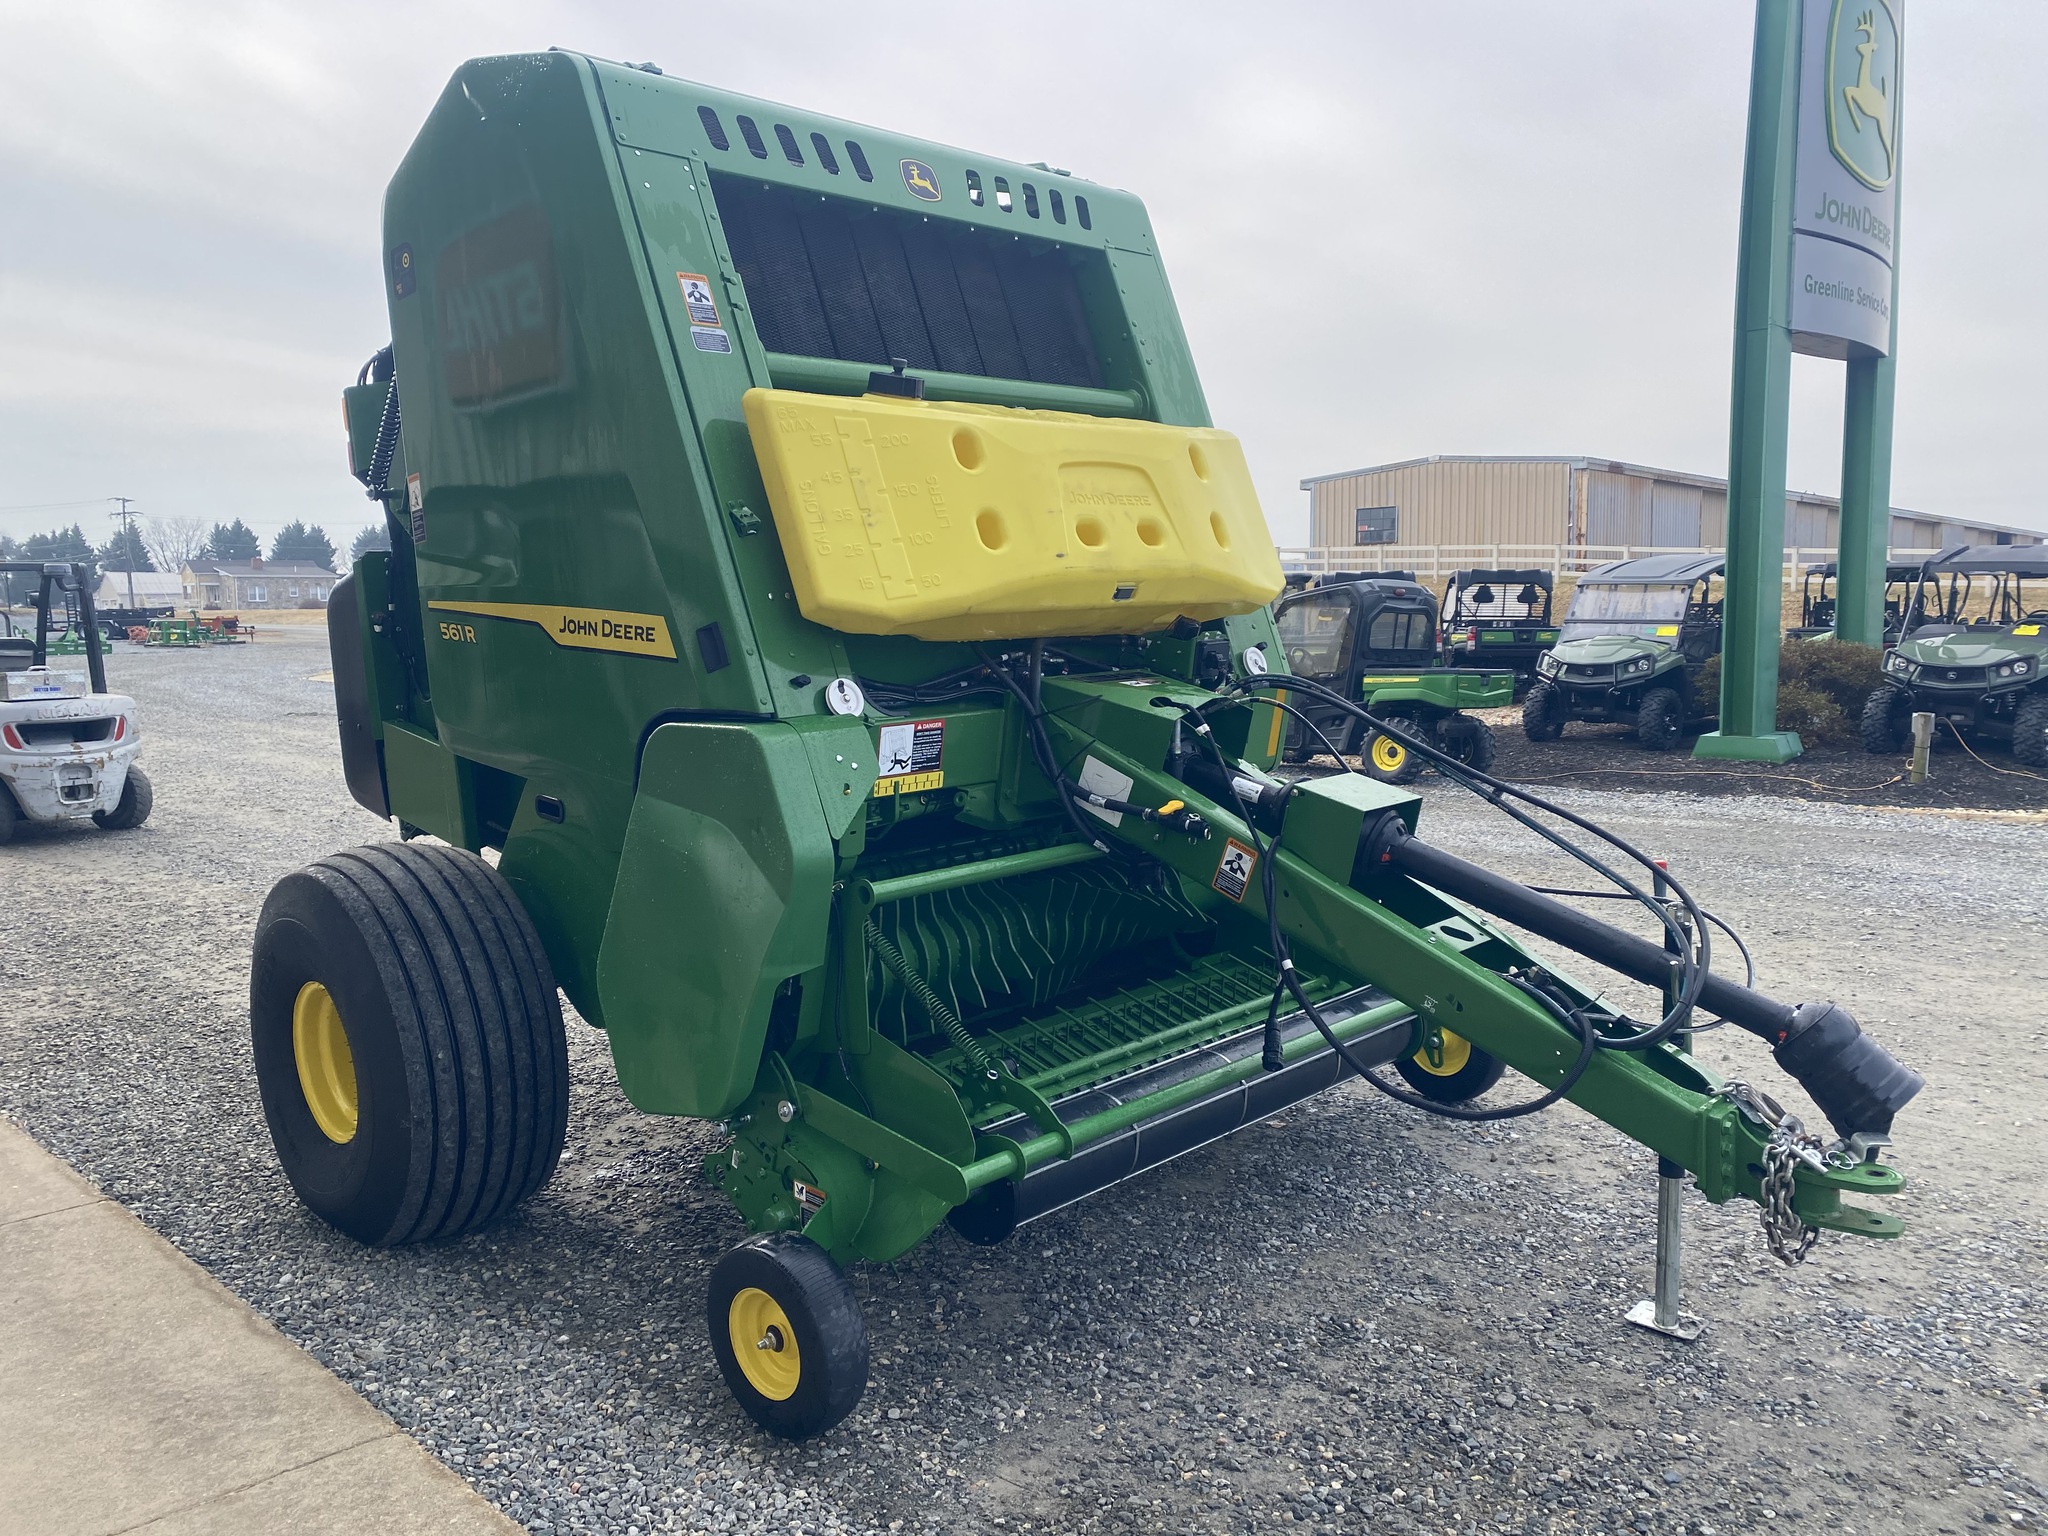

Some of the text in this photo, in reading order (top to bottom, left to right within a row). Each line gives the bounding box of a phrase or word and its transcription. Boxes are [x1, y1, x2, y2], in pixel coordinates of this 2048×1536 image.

[1814, 192, 1861, 231] JOHN
[1804, 273, 1854, 302] Greenline
[1857, 286, 1880, 313] Service
[777, 406, 799, 419] 65
[779, 418, 817, 433] MAX
[810, 432, 833, 446] 55
[880, 433, 911, 449] 200
[821, 470, 843, 484] 45
[893, 482, 919, 498] 150
[925, 474, 952, 529] LITERS
[1070, 491, 1151, 506] JOHN DEERE
[799, 480, 832, 556] GALLONS
[832, 508, 854, 522] 35
[909, 531, 934, 546] 100
[843, 543, 865, 558] 25
[859, 577, 874, 590] 15
[921, 573, 942, 587] 50
[559, 615, 656, 643] JOHN DEERE
[922, 722, 942, 730] DANGER
